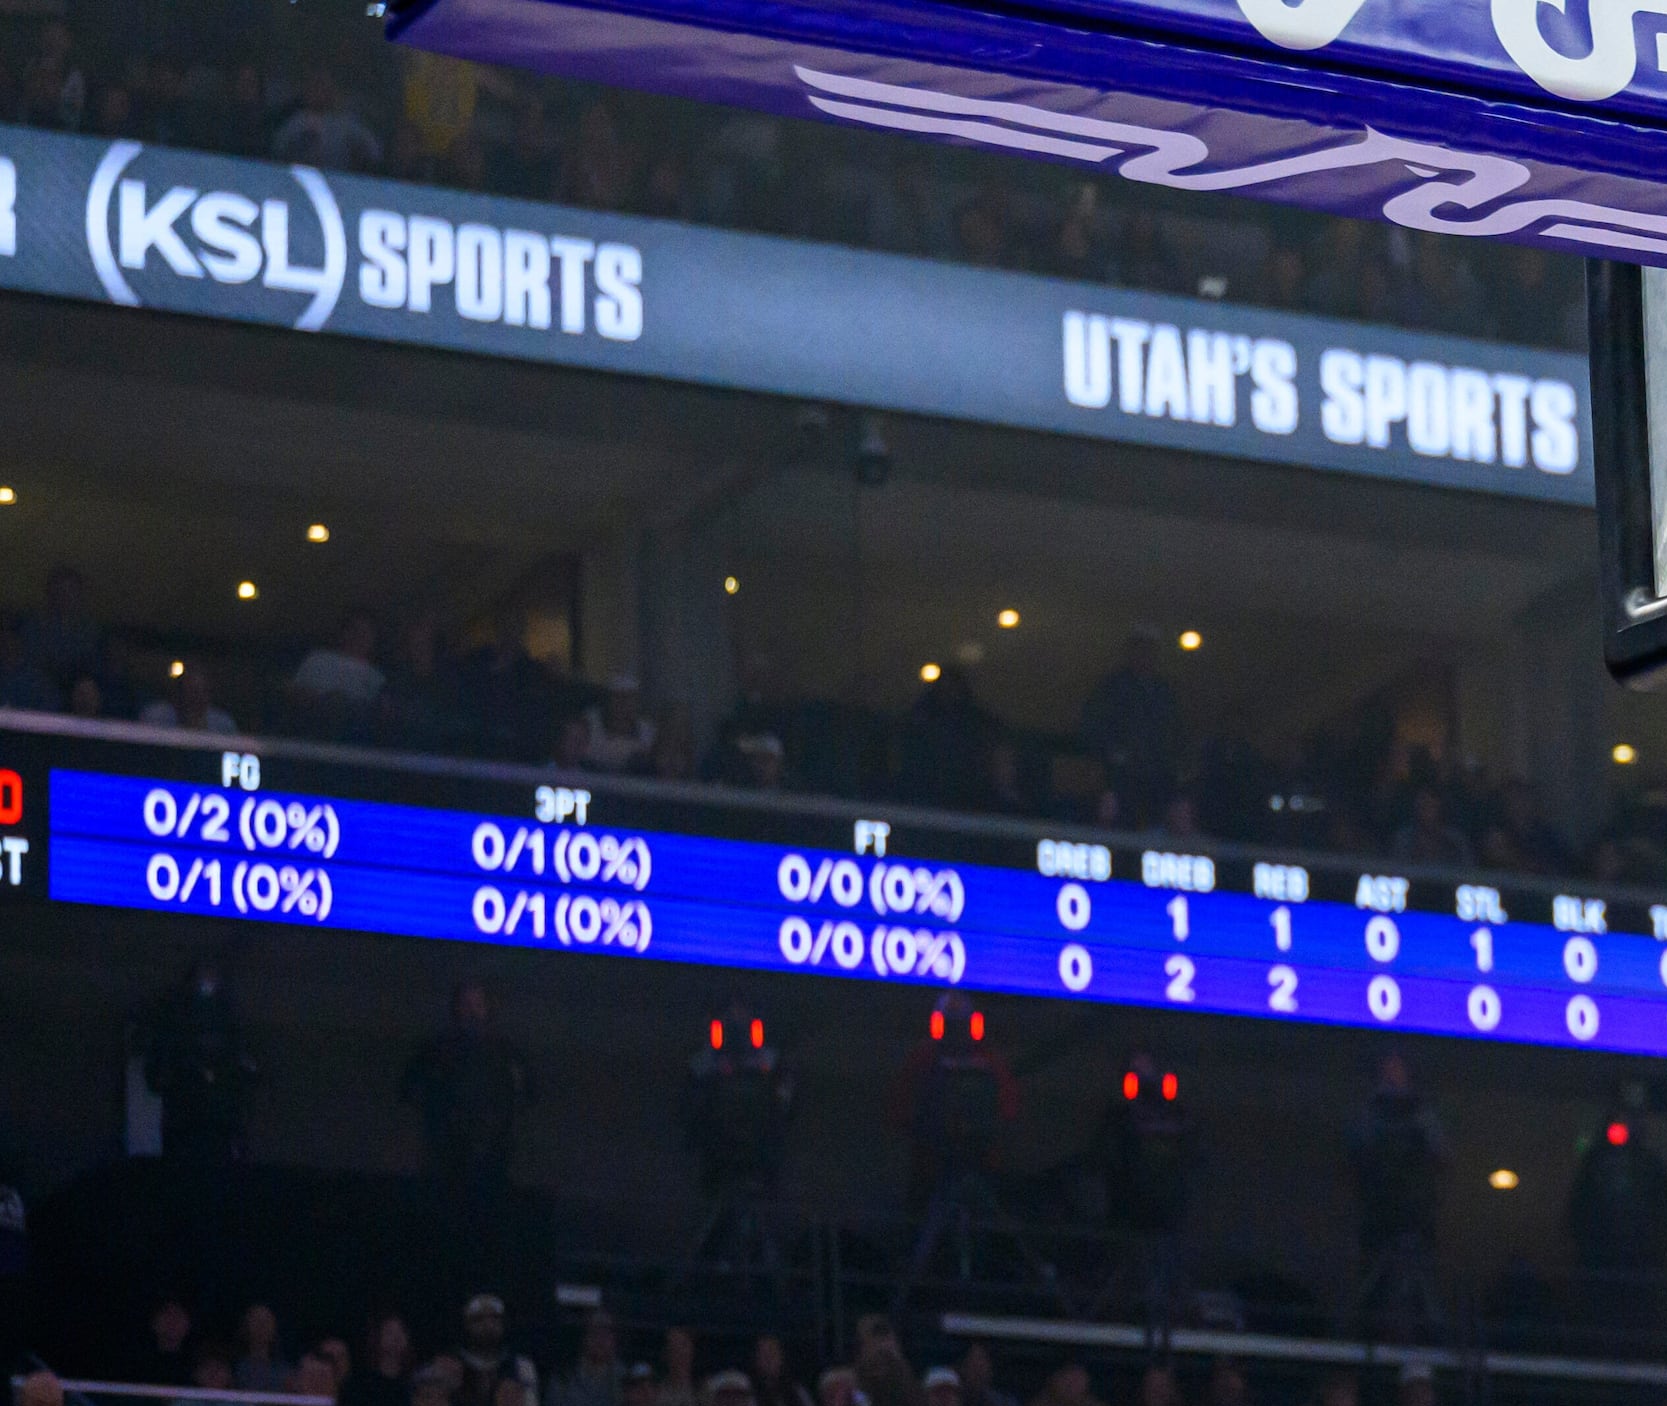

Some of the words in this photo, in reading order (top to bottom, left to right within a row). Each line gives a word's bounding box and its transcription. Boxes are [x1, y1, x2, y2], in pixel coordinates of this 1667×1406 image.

[359, 209, 644, 342] SPORTS
[1062, 310, 1300, 436] UTAH'S
[1319, 347, 1579, 475] SPORTS
[144, 789, 230, 842] 0/2
[240, 797, 340, 858] (0%)
[472, 823, 545, 875] 0/1
[554, 831, 652, 891] (0%)
[777, 854, 863, 907] 0/0
[869, 863, 965, 923] (0%)
[1057, 883, 1091, 930] 0
[1167, 895, 1189, 941] 1
[1269, 906, 1292, 952] 1
[1365, 915, 1399, 962] 0
[1470, 927, 1492, 972] 1
[1563, 936, 1598, 983] 0
[222, 752, 260, 790] FG
[535, 786, 591, 825] 3PT
[854, 819, 890, 857] FT
[1356, 874, 1409, 913] AST
[1456, 884, 1508, 925] STL
[147, 853, 221, 905] 0/1
[233, 860, 332, 922] (0%)
[472, 885, 545, 938] 0/1
[554, 894, 653, 952] (0%)
[779, 916, 864, 969] 0/0
[871, 925, 966, 984] (0%)
[1058, 944, 1092, 992] 0
[1165, 955, 1195, 1002] 2
[1268, 964, 1297, 1012] 2
[1367, 974, 1401, 1022] 0
[1467, 985, 1501, 1031] 0
[1566, 995, 1599, 1041] 0
